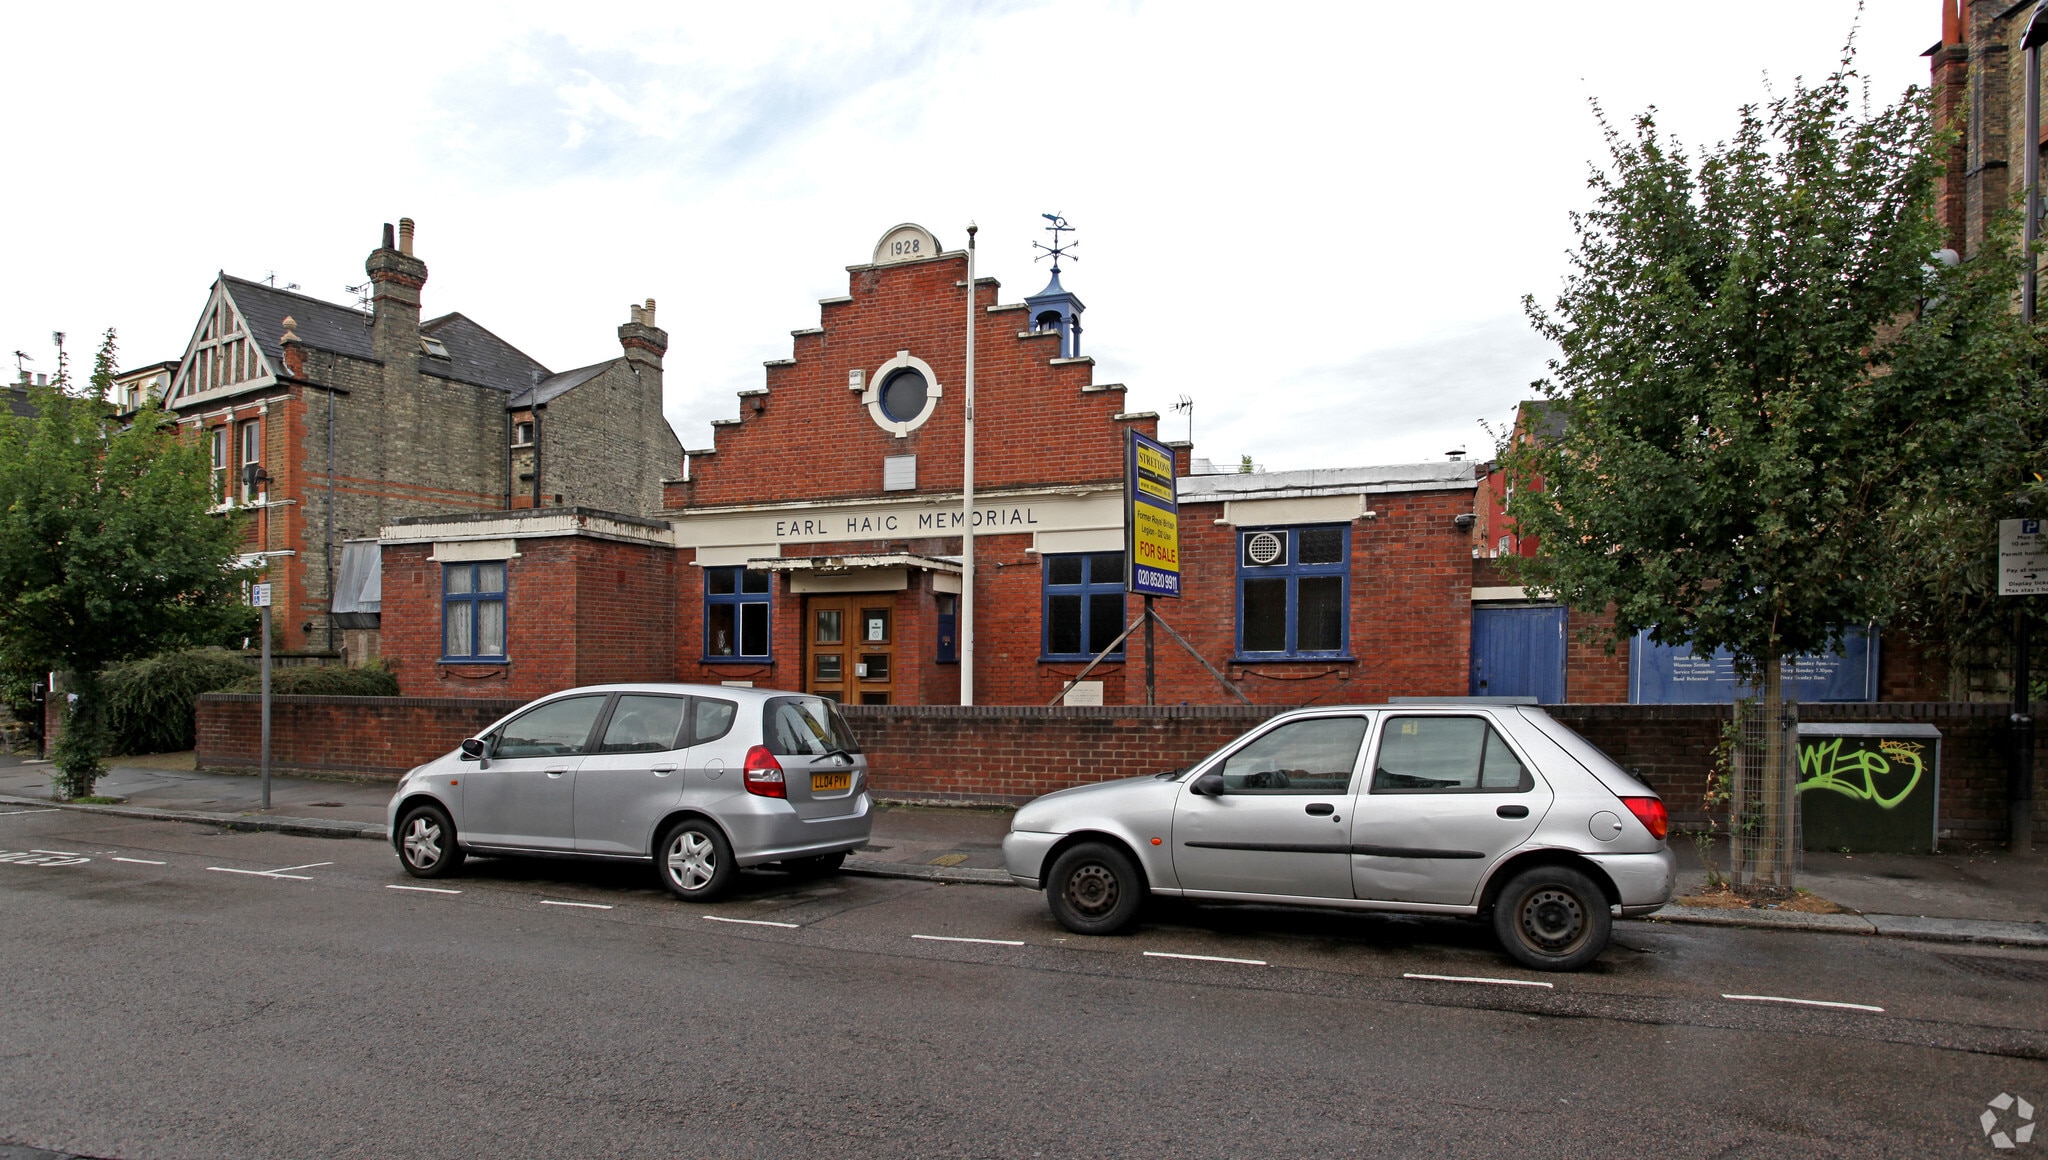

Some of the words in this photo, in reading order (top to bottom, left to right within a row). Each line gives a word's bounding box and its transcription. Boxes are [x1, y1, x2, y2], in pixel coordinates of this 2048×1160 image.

[891, 239, 919, 256] 1928
[1139, 452, 1170, 474] STRETTONS
[776, 519, 828, 536] EARL
[918, 508, 1038, 529] MEMORIAL
[1137, 510, 1151, 522] Former
[1152, 515, 1162, 526] Royal
[1163, 519, 1175, 530] British
[1141, 524, 1154, 537] Legion
[1140, 541, 1155, 559] FOR
[1157, 546, 1176, 563] SALE
[1138, 569, 1149, 586] 020
[1150, 571, 1164, 588] 8520
[1165, 574, 1177, 590] 9911
[815, 776, 833, 788] LL04
[834, 775, 847, 788] PYV
